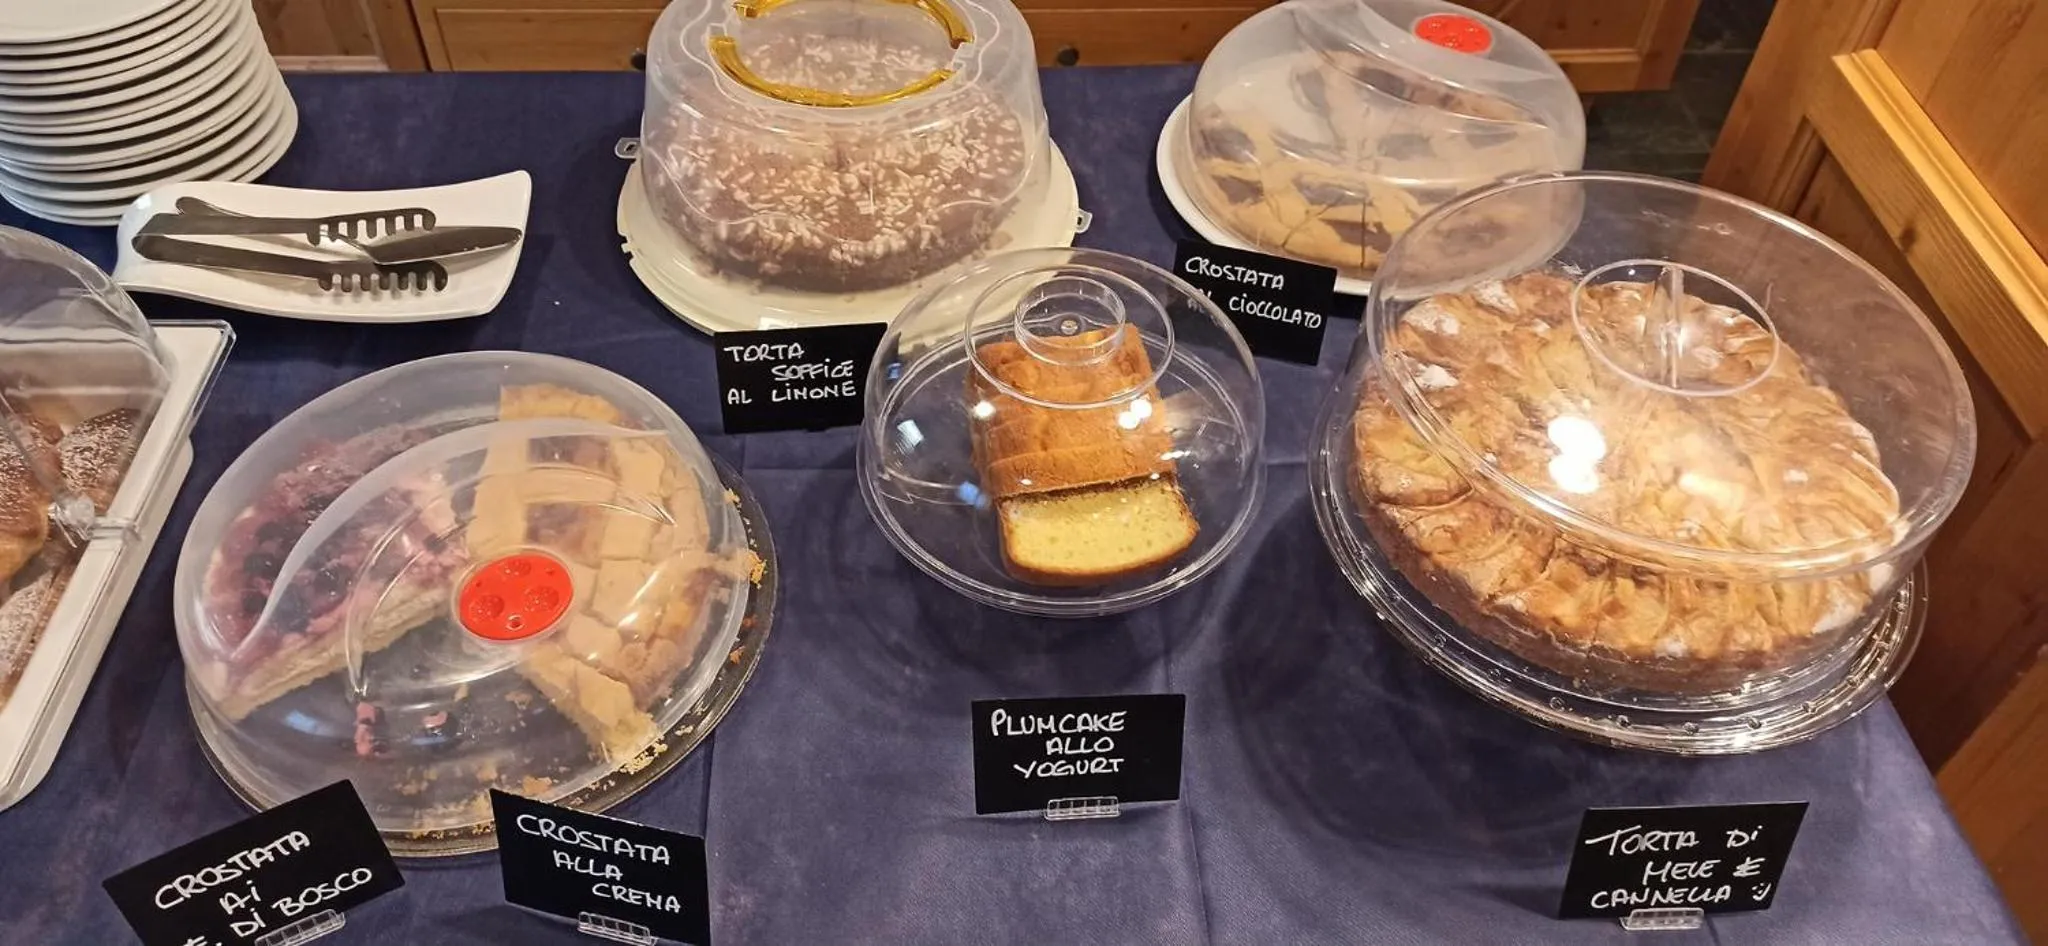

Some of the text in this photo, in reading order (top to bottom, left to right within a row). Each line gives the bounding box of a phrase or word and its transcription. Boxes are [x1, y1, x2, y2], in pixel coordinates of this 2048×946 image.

[1184, 256, 1287, 292] CROSTATA
[724, 343, 804, 361] TORTA
[728, 389, 752, 404] AL
[992, 709, 1126, 738] PLUMCAKE
[1046, 737, 1114, 755] ALLO
[1014, 757, 1124, 778] YOGURT
[517, 812, 669, 867] CROSTATA
[1585, 825, 1699, 855] TORTA
[156, 831, 314, 912] CROSTATA
[553, 849, 626, 880] ALLA
[1643, 860, 1720, 885] MELE
[272, 868, 372, 919] BOSCO
[590, 883, 680, 915] CREMA
[1591, 884, 1731, 911] CANNELLA
